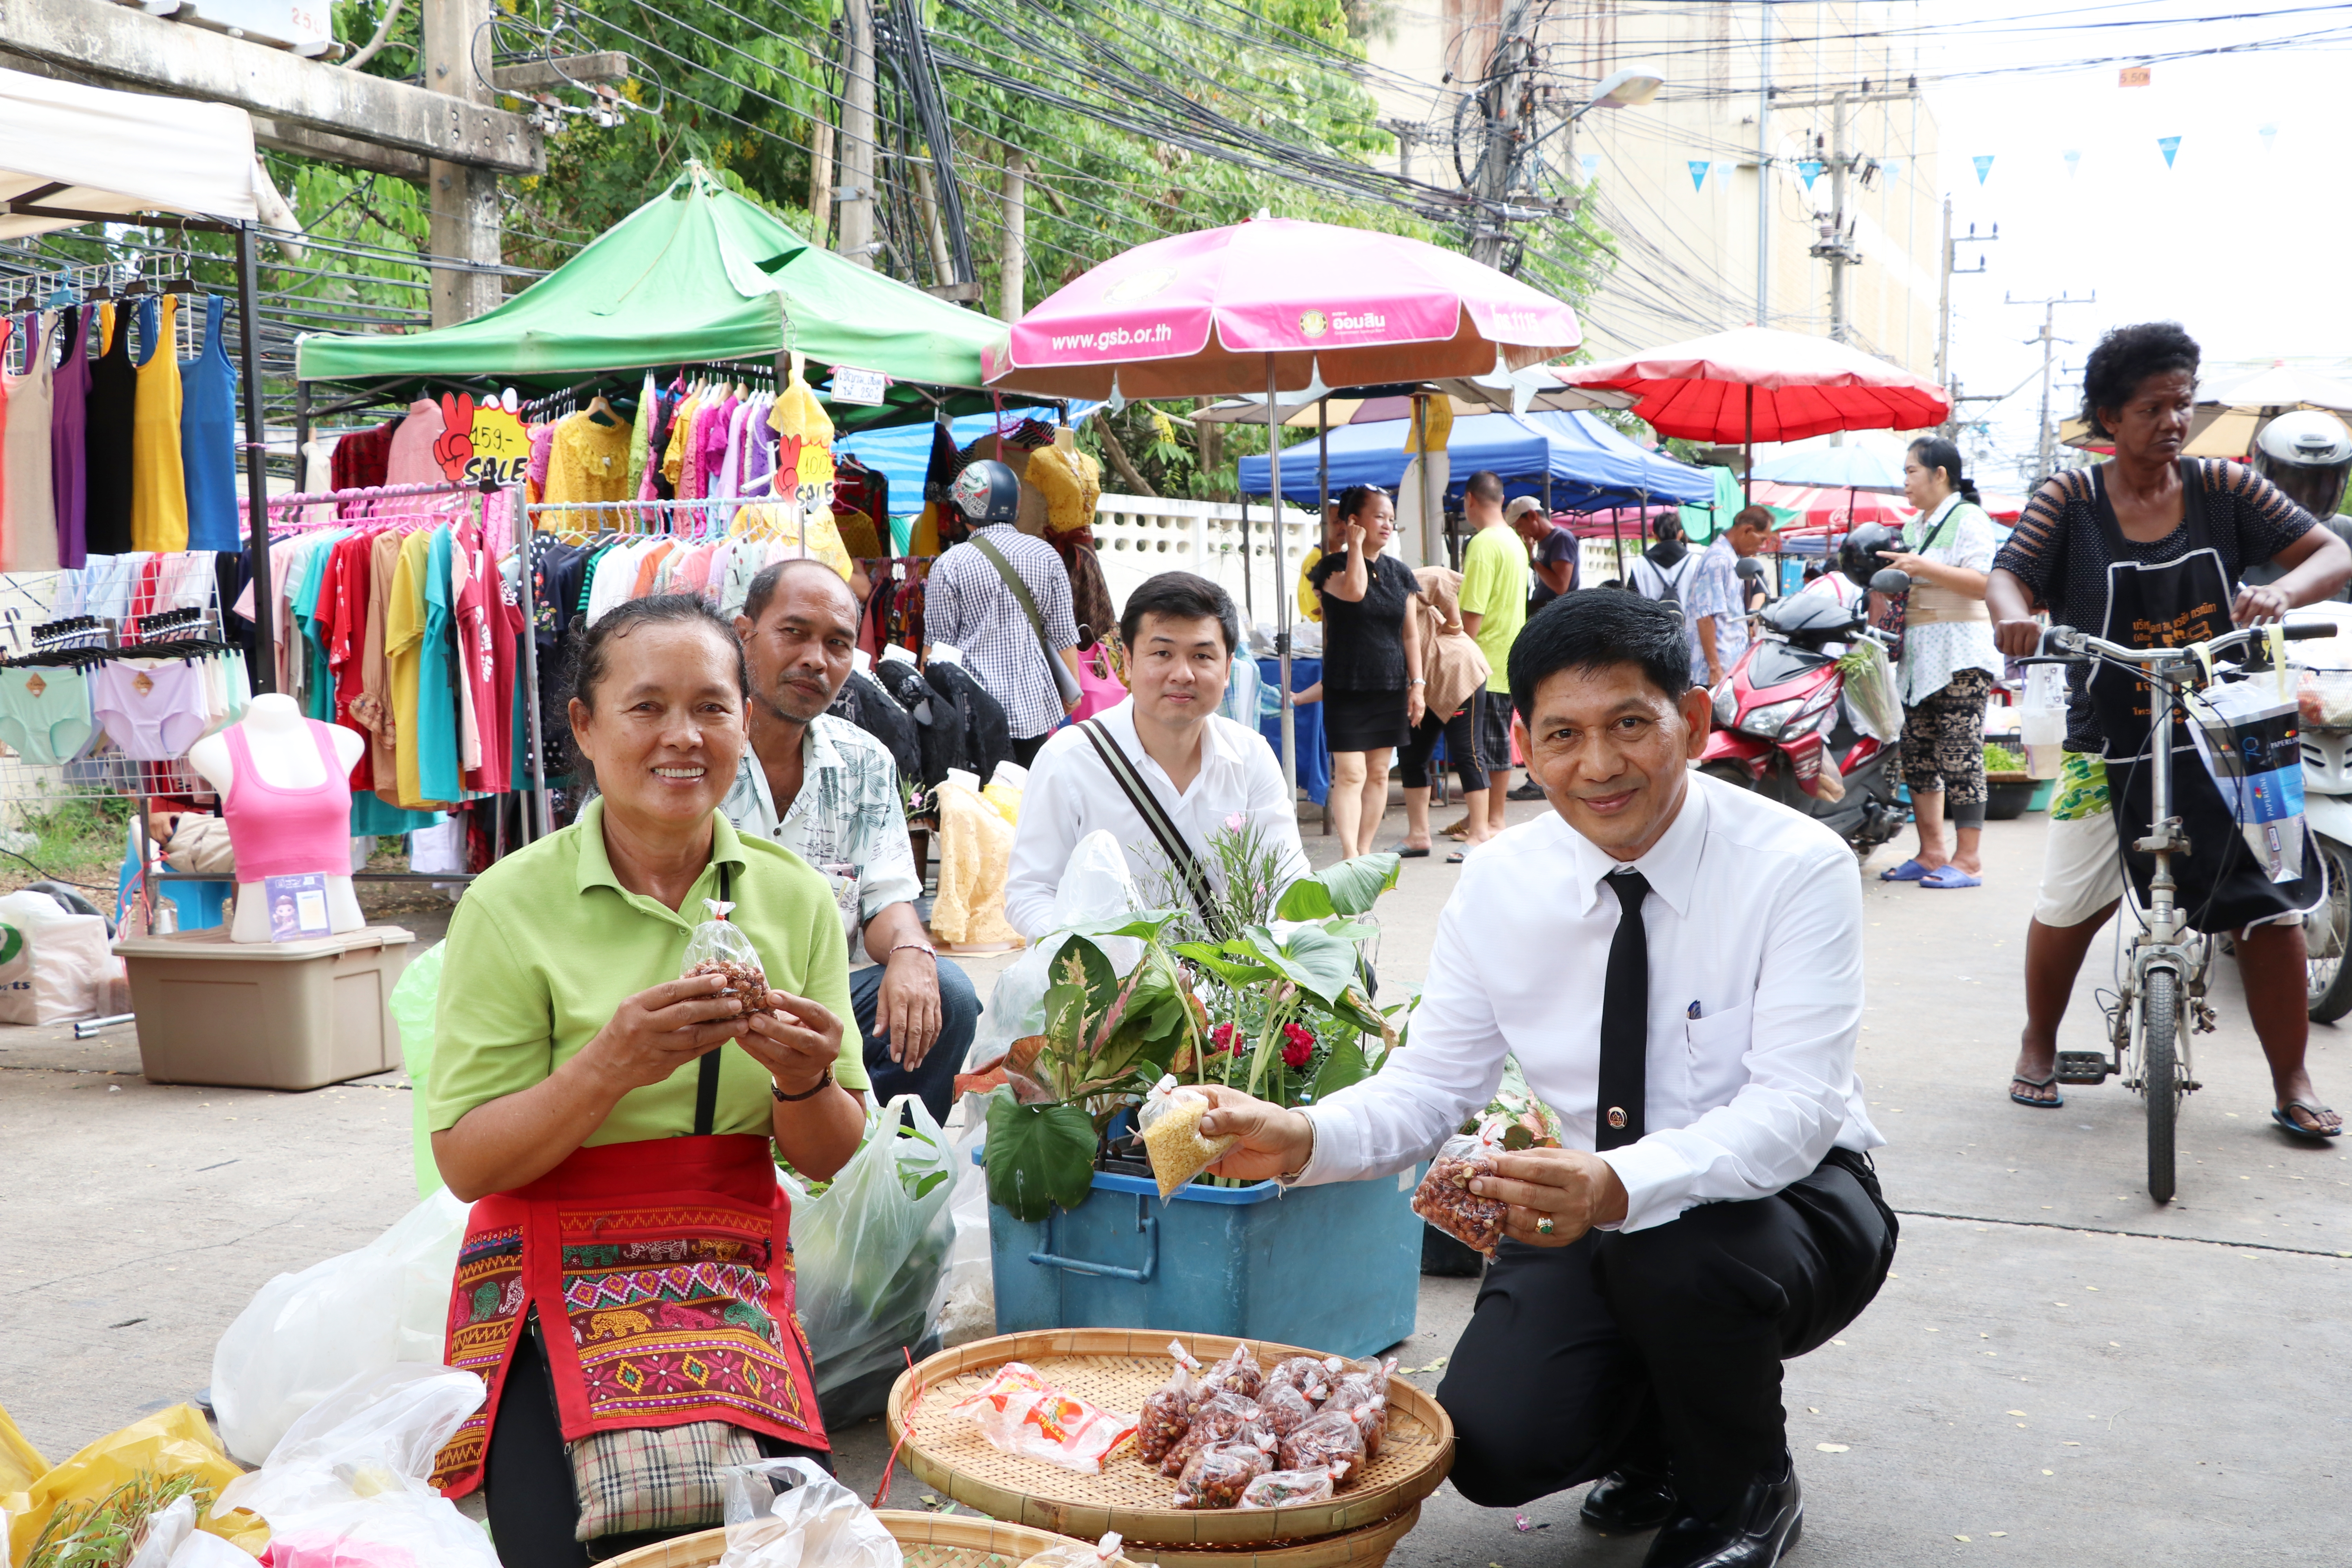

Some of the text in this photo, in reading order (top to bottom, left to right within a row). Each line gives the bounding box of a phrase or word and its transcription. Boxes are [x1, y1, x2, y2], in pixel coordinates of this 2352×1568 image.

[1333, 312, 1386, 330] ออมสิน
[1052, 323, 1172, 351] www.gsb.or.th
[860, 387, 874, 398] 250
[464, 457, 528, 483] SALE
[795, 481, 833, 506] SALE
[955, 481, 987, 510] DNOSAUR
[956, 492, 984, 515] RACING
[1796, 746, 1819, 759] HONDA
[2270, 737, 2300, 749] PAPERLIN
[2259, 776, 2274, 817] PAPERLINE
[1037, 1414, 1068, 1443] ตราส้ม
